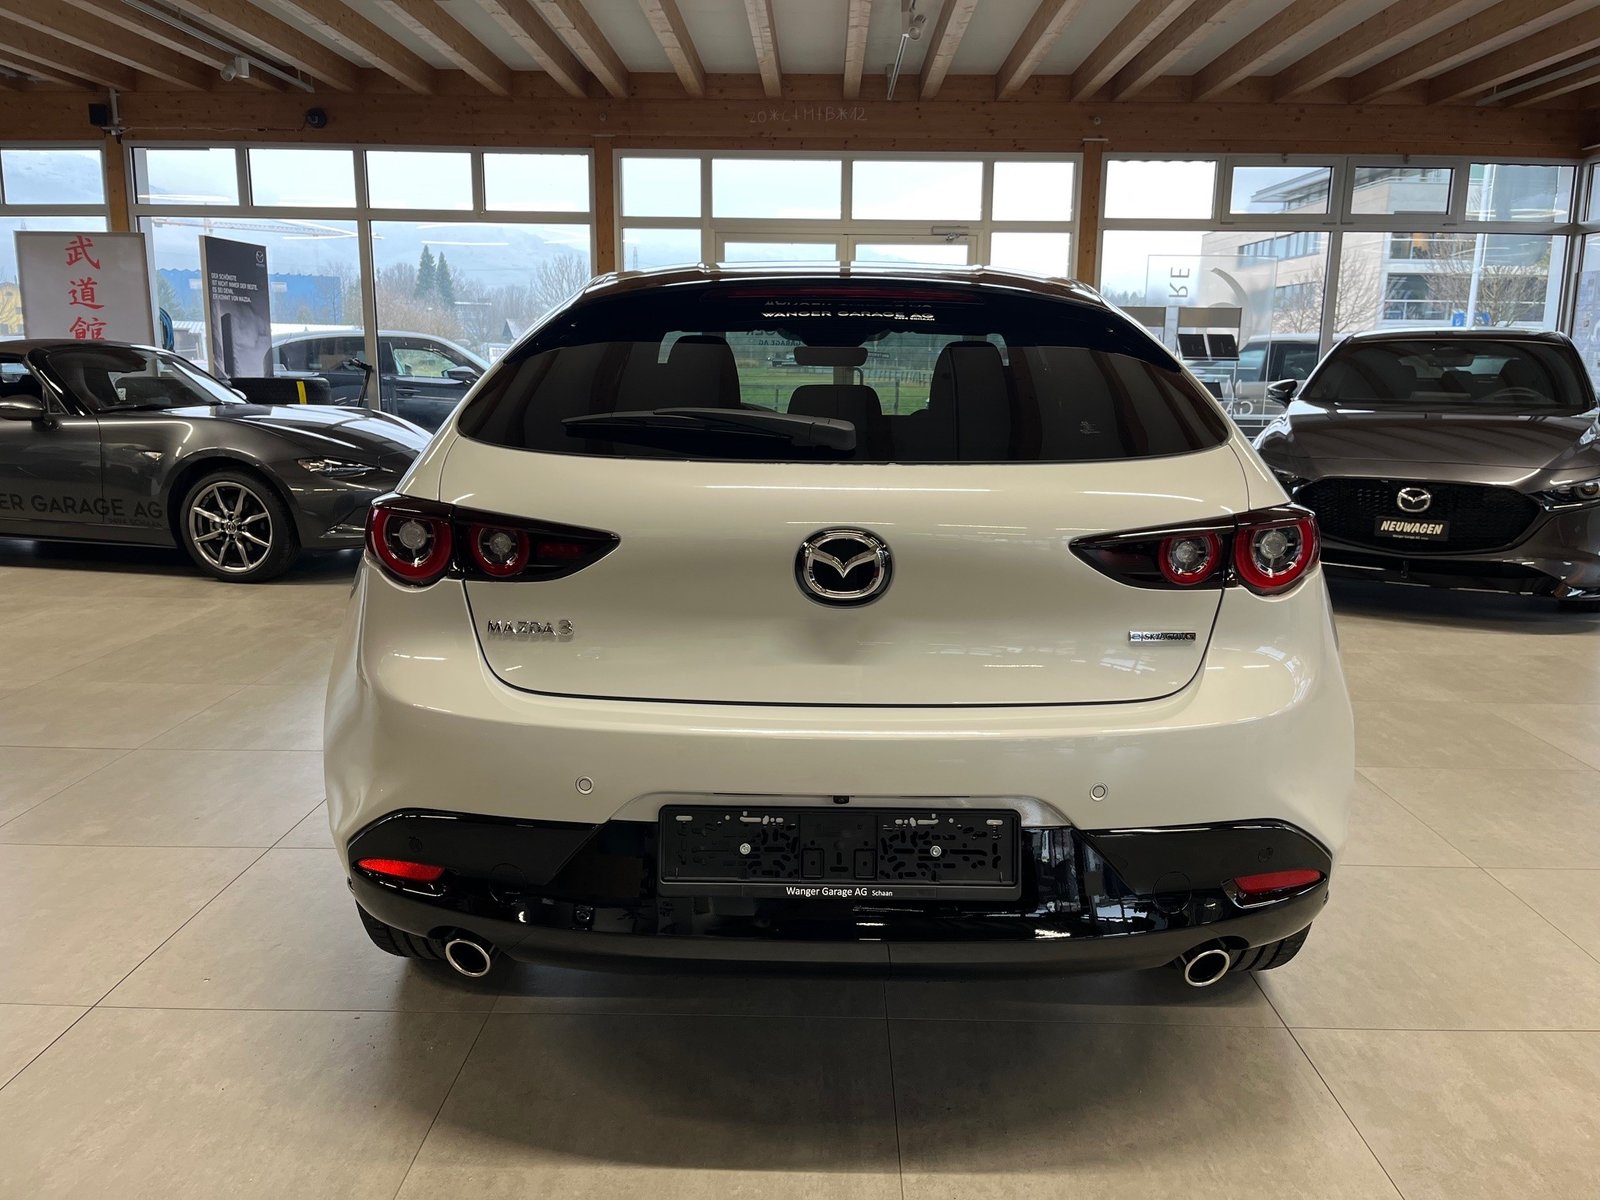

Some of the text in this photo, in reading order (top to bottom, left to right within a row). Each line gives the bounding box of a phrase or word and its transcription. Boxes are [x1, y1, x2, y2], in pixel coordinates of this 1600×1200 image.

[762, 310, 832, 318] WANGER
[31, 495, 126, 517] GARAGE
[133, 501, 163, 519] AG
[1380, 520, 1444, 535] NEUWAGEN
[786, 886, 893, 897] Wanger Garage AG Schaan
